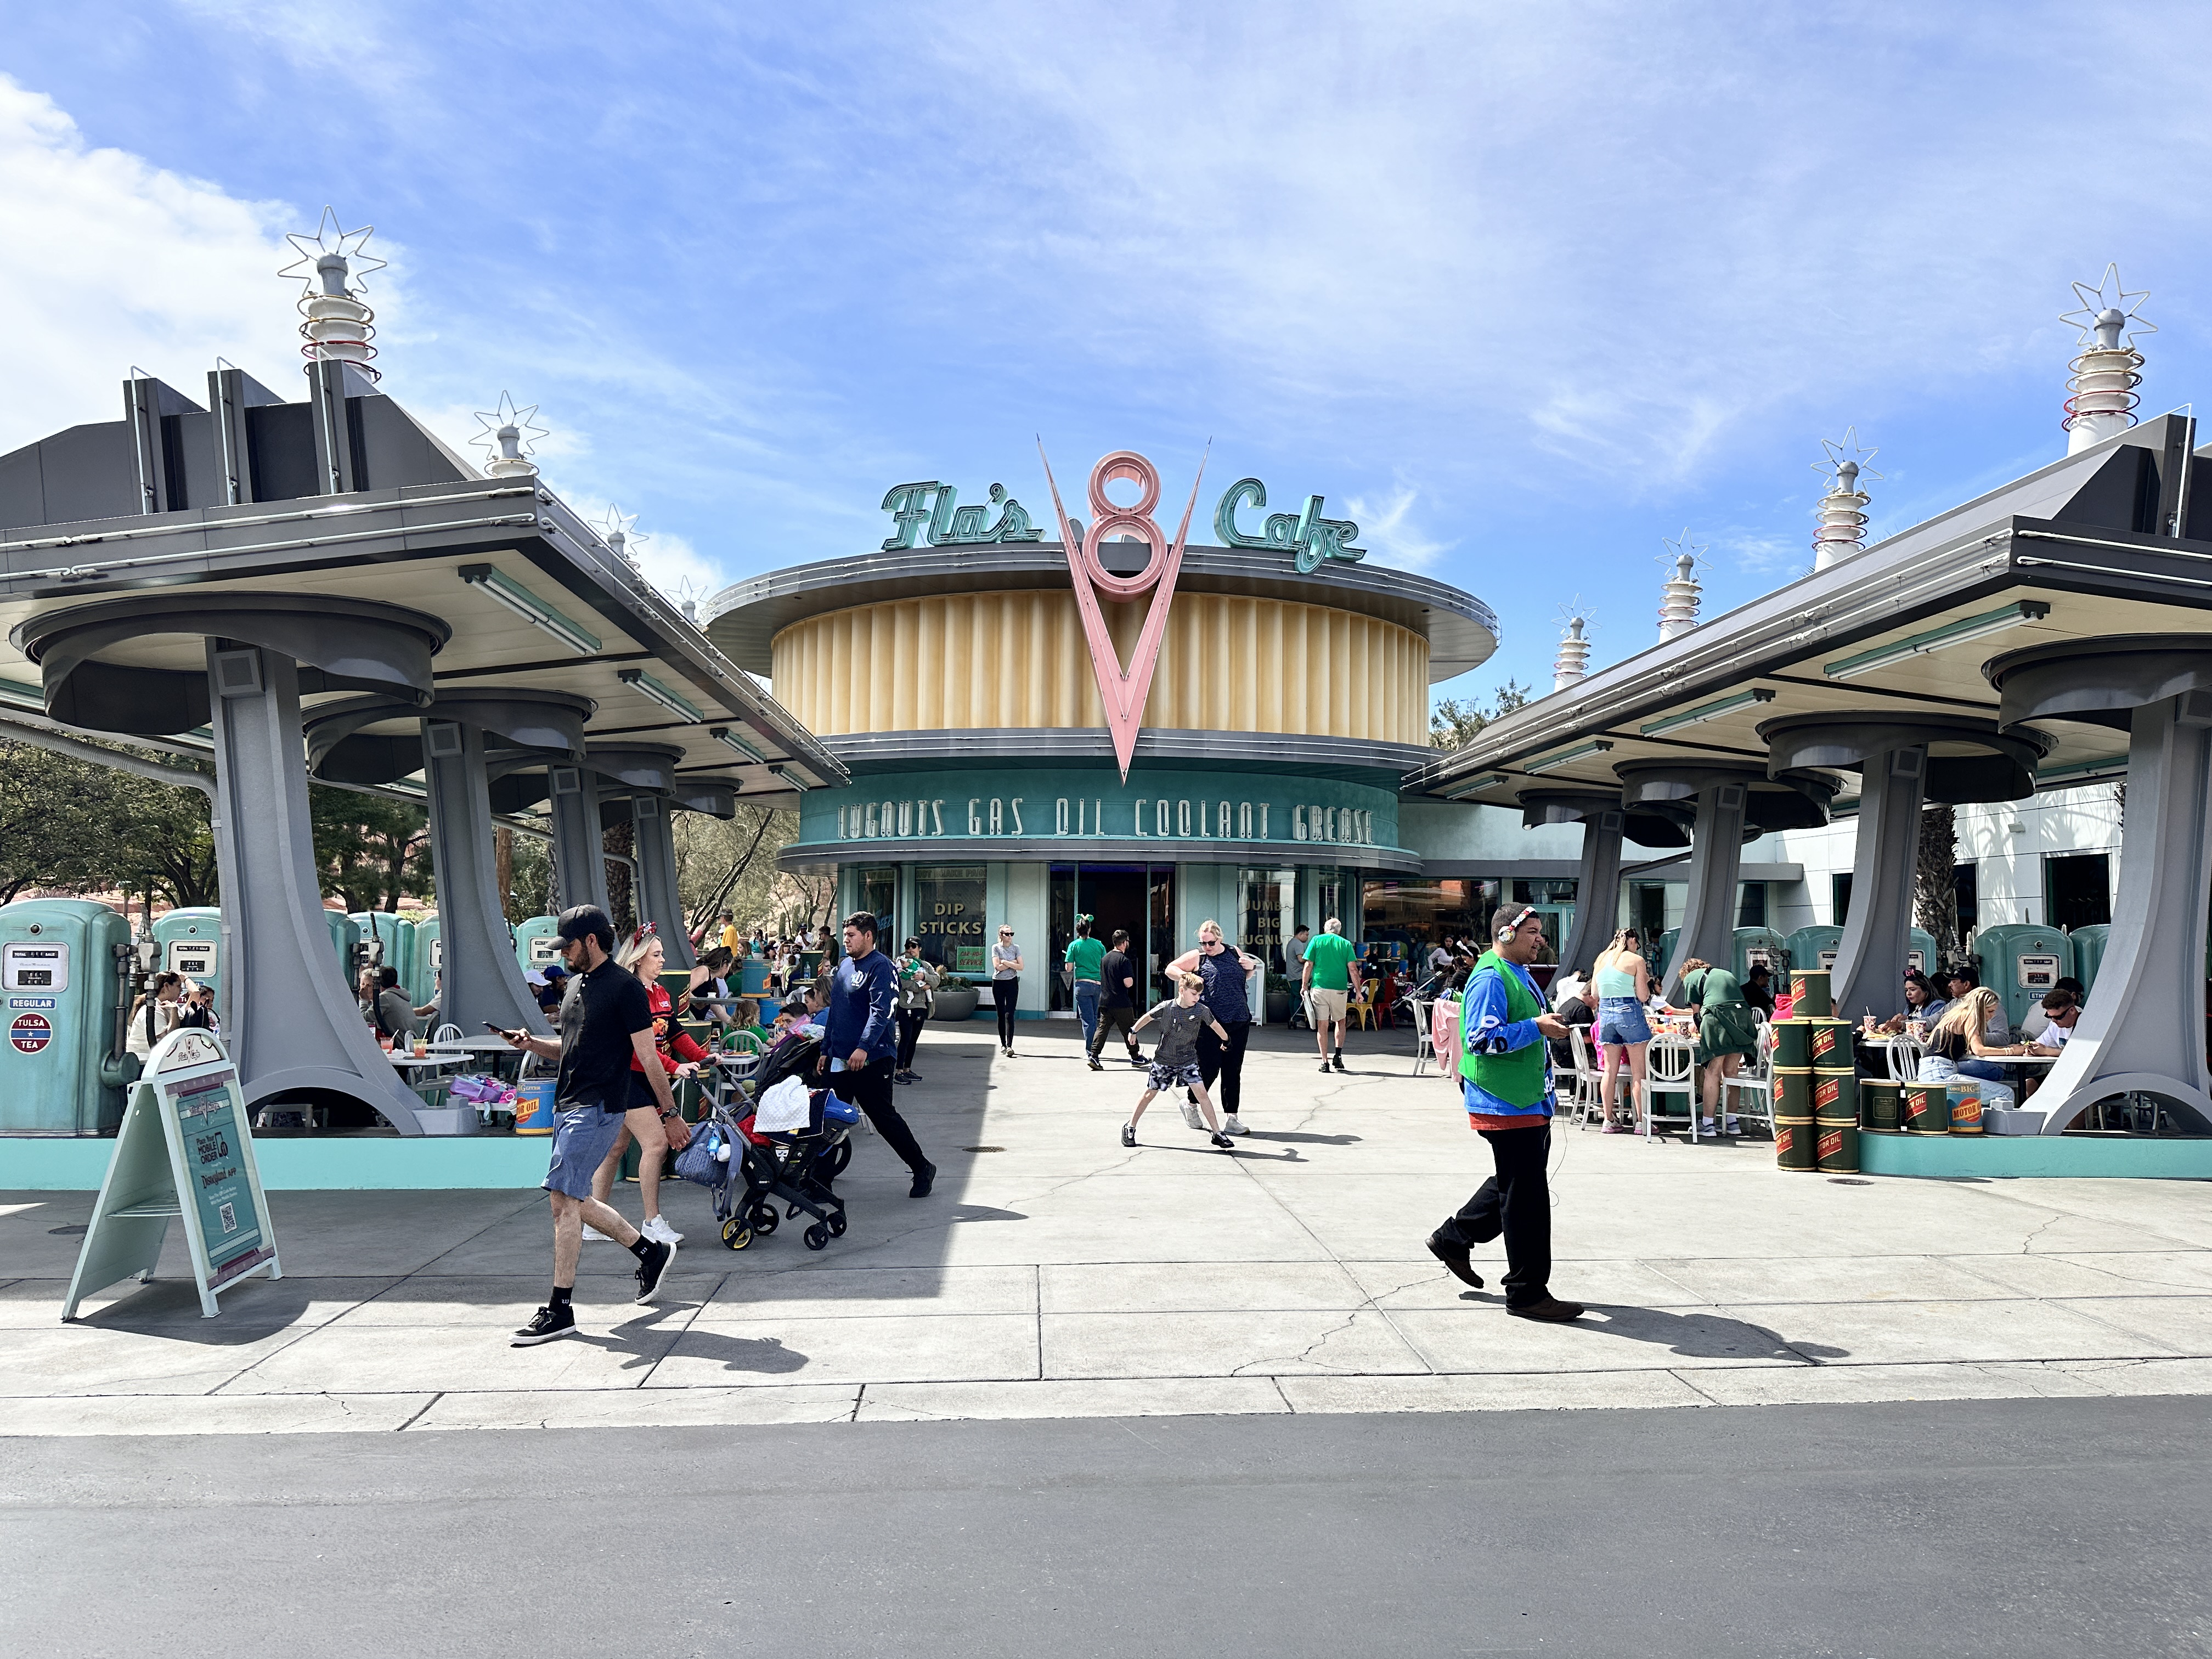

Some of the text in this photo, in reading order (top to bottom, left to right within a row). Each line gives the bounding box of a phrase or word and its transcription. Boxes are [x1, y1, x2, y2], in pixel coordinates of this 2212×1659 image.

[881, 479, 1046, 551] Flo's
[1214, 478, 1367, 574] Cafe
[838, 798, 1374, 845] LUGNUTS GAS OIL COOLANT GREASE
[935, 903, 965, 916] DIP
[919, 922, 982, 934] STICKS
[1258, 917, 1280, 928] BIG
[1238, 934, 1295, 945] LUGNU
[1823, 1033, 1833, 1043] OIL
[1827, 1084, 1837, 1094] OIL
[526, 1101, 538, 1111] OIL
[1915, 1096, 1926, 1105] OIL
[1953, 1105, 1976, 1119] MOTOR
[1782, 1133, 1791, 1142] OIL
[1830, 1135, 1841, 1145] OIL
[198, 1142, 217, 1155] MOBILE
[201, 1152, 218, 1164] ORDER
